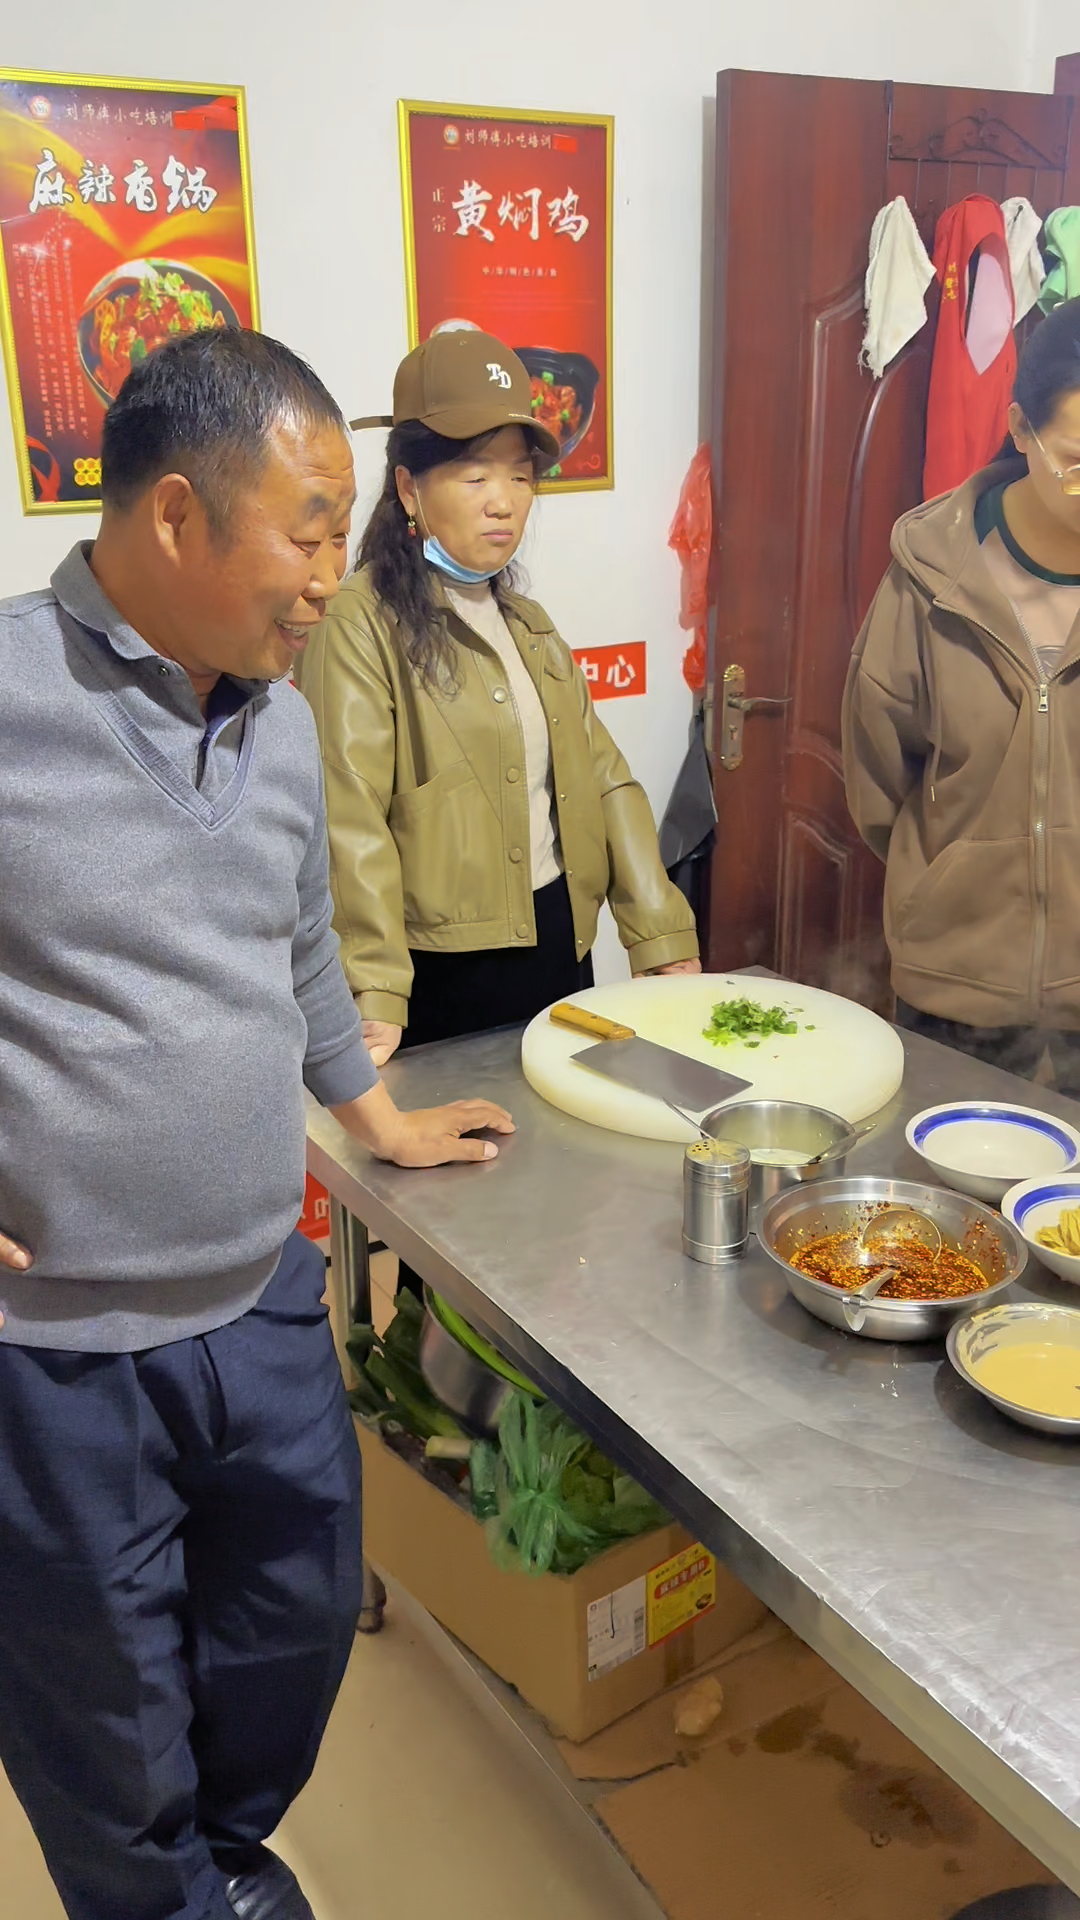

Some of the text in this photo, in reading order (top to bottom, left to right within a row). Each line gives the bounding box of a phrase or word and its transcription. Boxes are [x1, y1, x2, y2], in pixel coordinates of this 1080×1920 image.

[65, 102, 174, 127] 刘师傅小吃培训
[464, 128, 552, 150] 刘师傅小吃培训
[29, 147, 218, 213] 麻辣香锅
[431, 186, 447, 233] 正宗
[451, 179, 590, 242] 黄焖鸡
